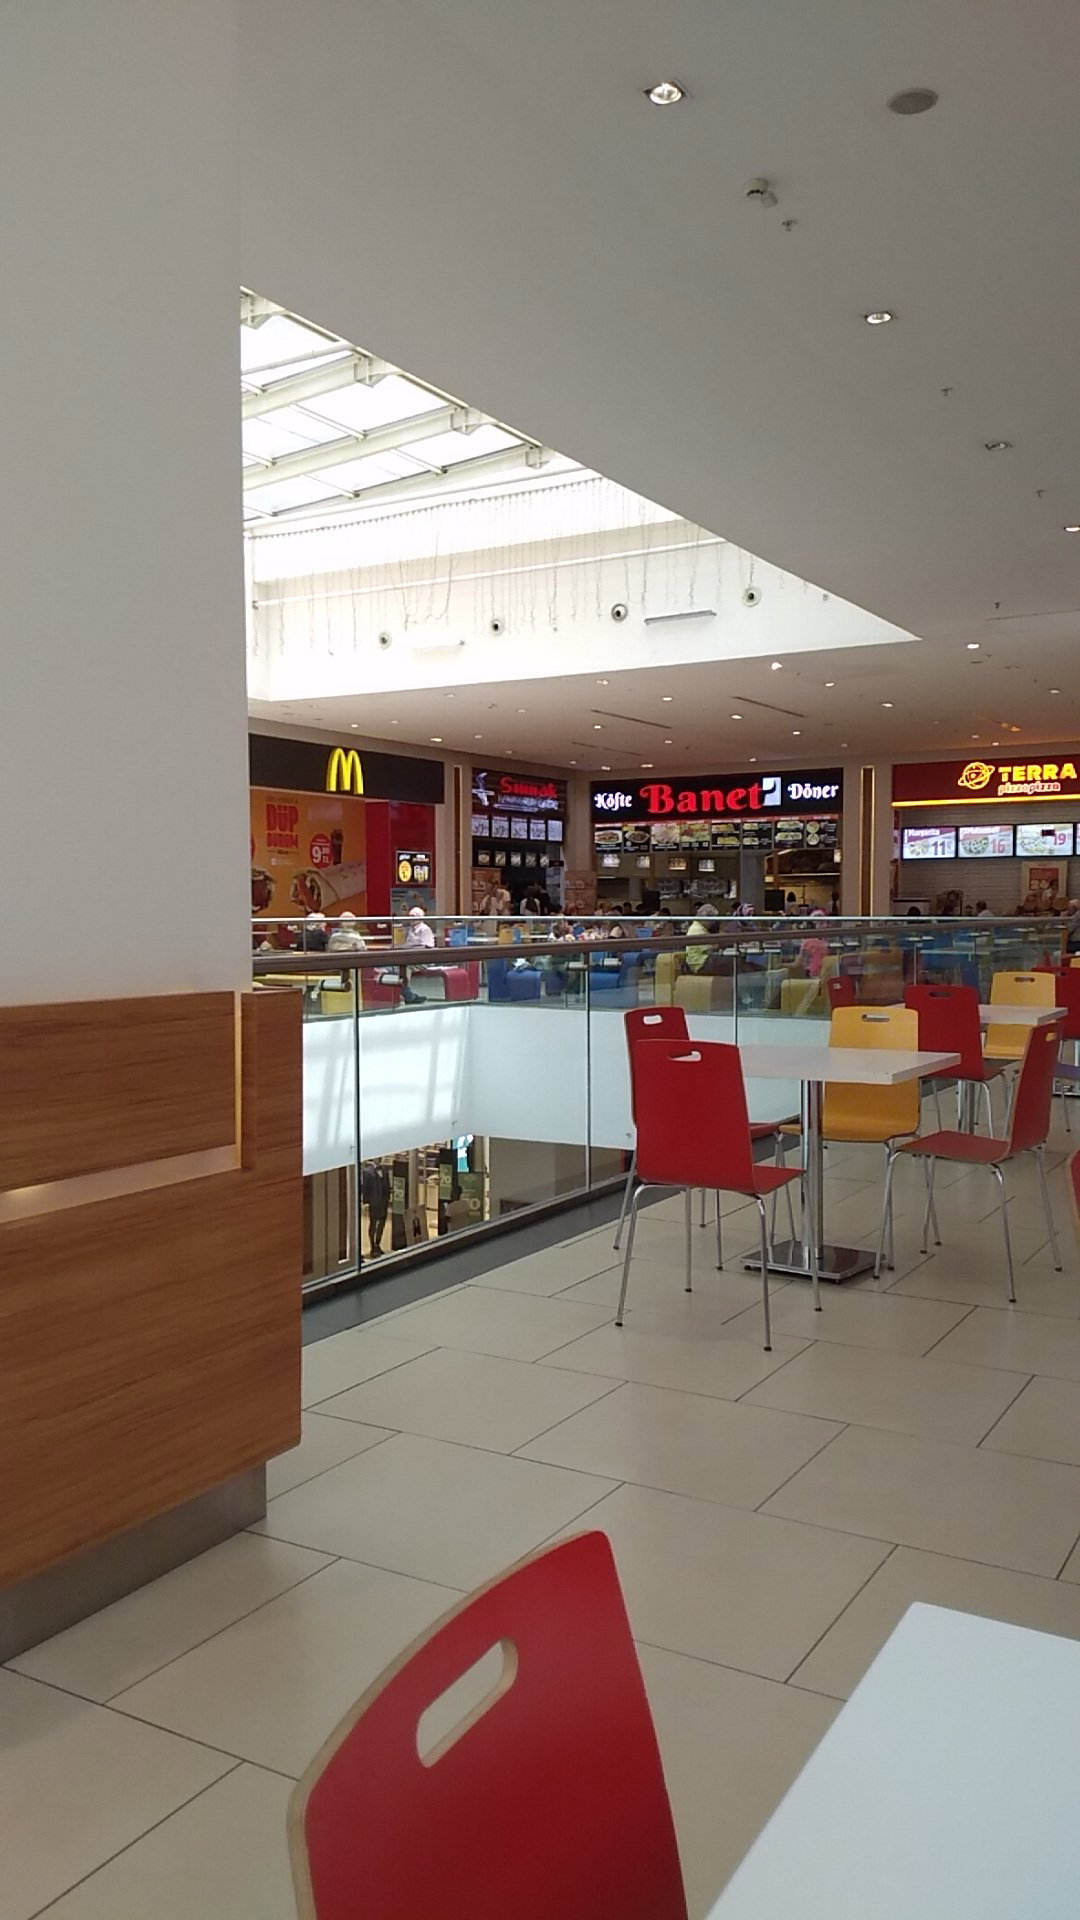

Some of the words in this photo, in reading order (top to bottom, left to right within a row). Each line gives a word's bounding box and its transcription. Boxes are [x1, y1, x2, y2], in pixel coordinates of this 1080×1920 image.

[998, 763, 1077, 782] TERRA
[998, 781, 1061, 796] pizzapizza
[594, 791, 633, 811] Köfte
[640, 783, 764, 814] Banet
[787, 783, 839, 800] Döner
[931, 840, 946, 855] 11
[992, 839, 1005, 853] 16
[312, 846, 321, 863] 9
